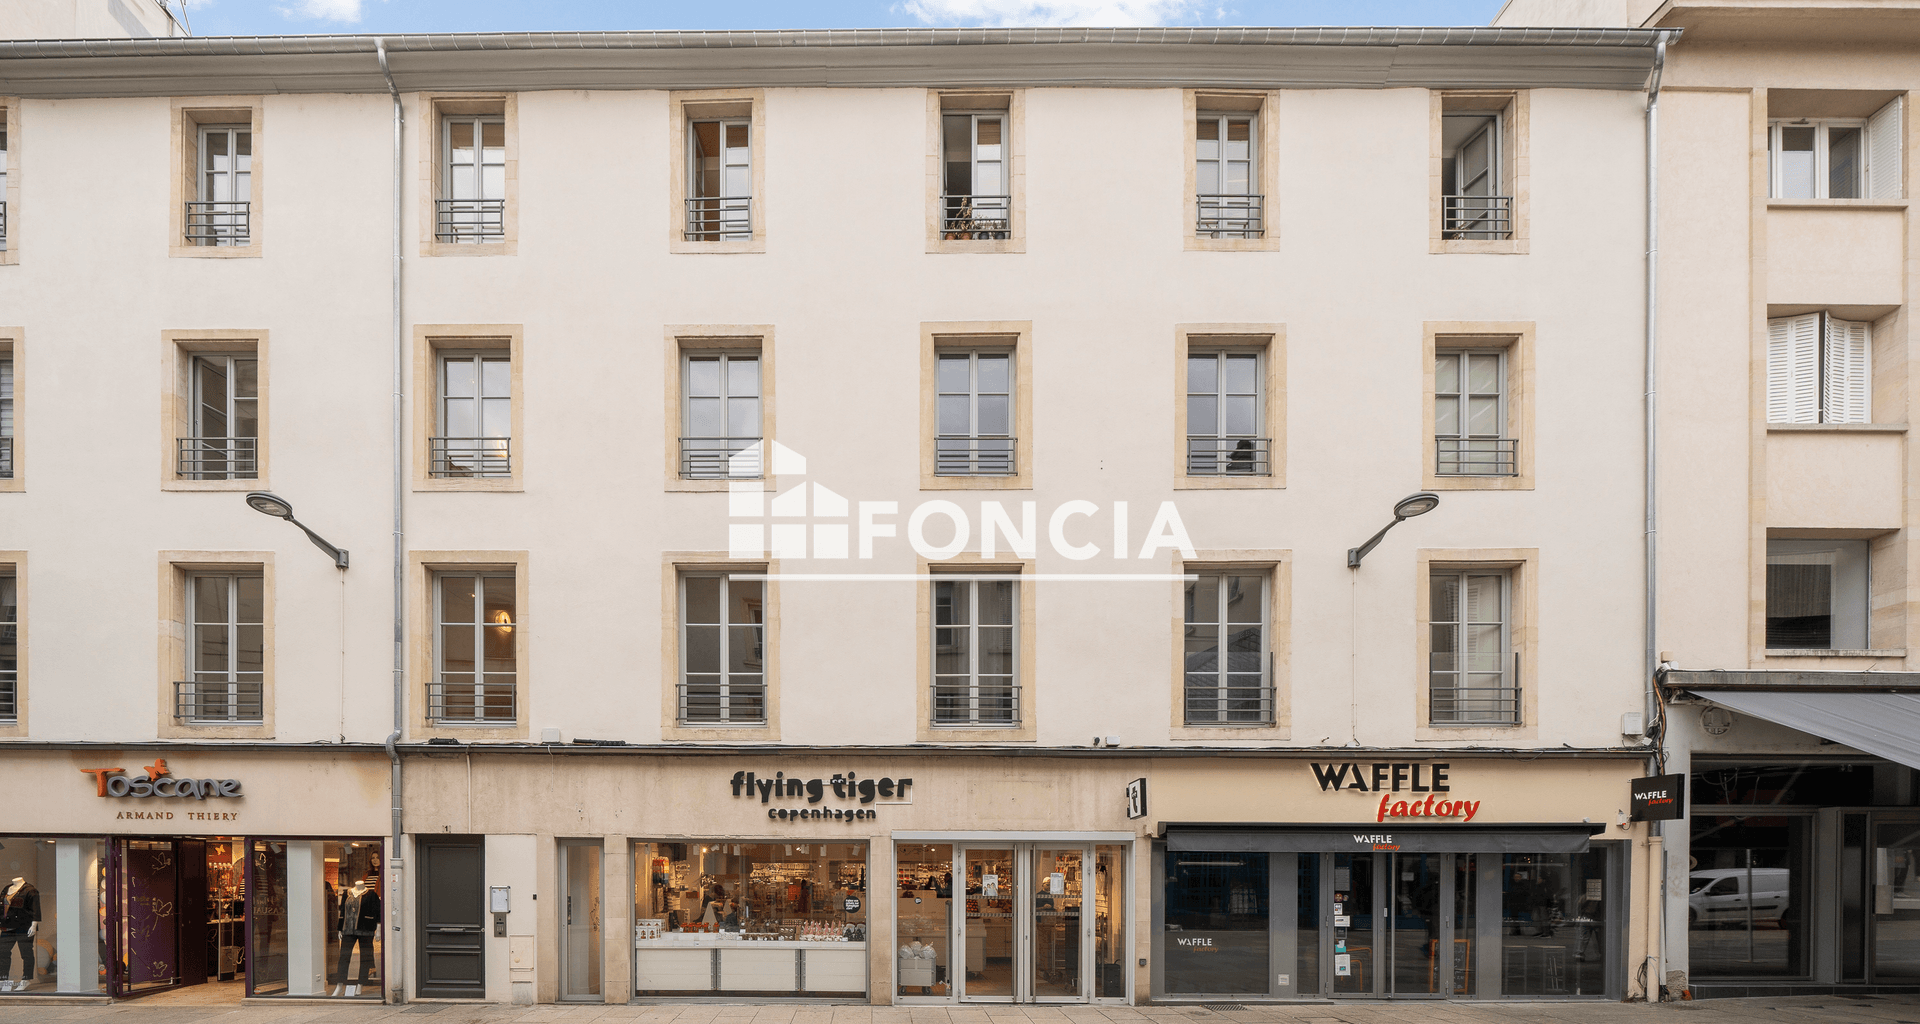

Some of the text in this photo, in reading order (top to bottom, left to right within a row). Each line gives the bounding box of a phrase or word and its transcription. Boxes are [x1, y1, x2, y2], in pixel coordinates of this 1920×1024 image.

[1310, 763, 1450, 792] WAFFLE
[80, 768, 244, 800] Toscane
[730, 771, 912, 804] flying tiger
[1634, 790, 1667, 800] WAFFLE
[1648, 798, 1673, 806] factory
[1377, 794, 1480, 822] factory
[116, 811, 238, 821] ARMAND THIERY
[768, 806, 876, 822] copenhagen
[1353, 834, 1393, 844] WAFFLE
[1372, 843, 1401, 852] factory
[1177, 938, 1212, 946] WAFFLE
